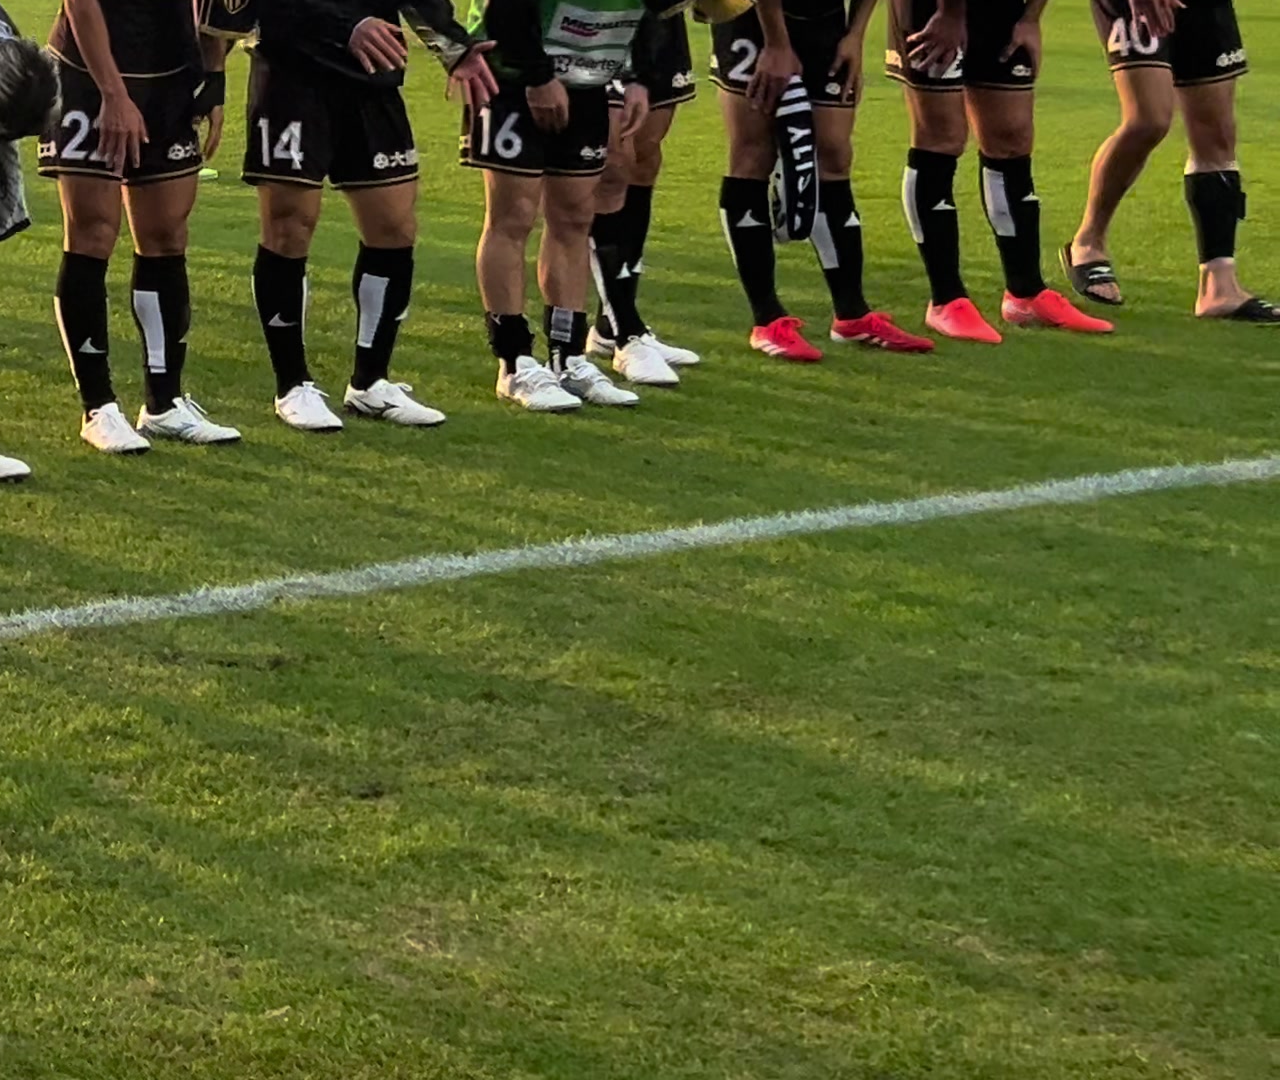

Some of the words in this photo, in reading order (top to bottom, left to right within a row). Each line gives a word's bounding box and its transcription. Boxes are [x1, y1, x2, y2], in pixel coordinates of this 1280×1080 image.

[1107, 17, 1159, 57] 40
[257, 116, 305, 170] 14
[480, 106, 523, 160] 16
